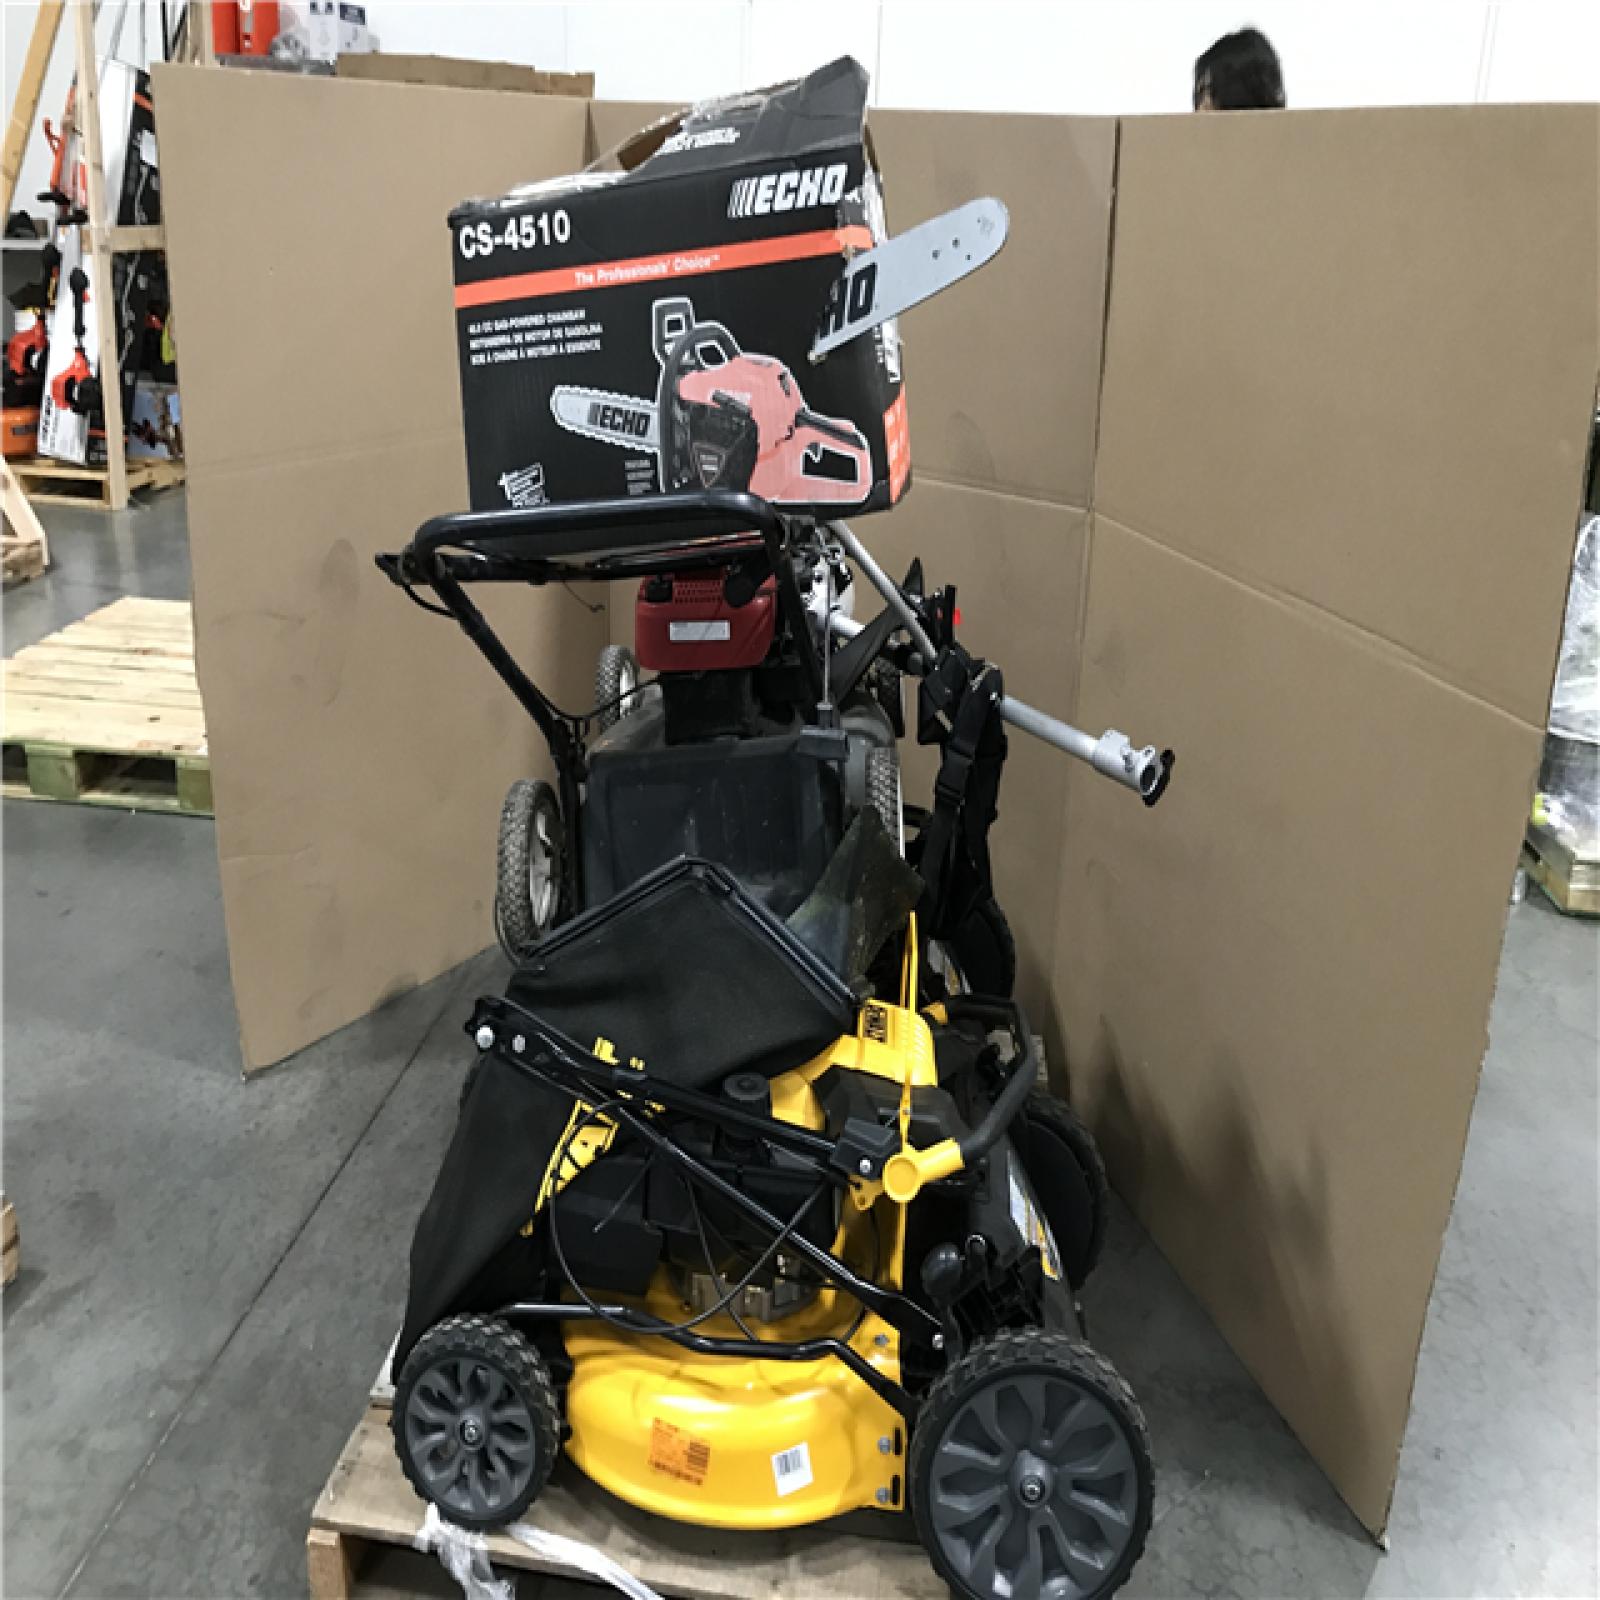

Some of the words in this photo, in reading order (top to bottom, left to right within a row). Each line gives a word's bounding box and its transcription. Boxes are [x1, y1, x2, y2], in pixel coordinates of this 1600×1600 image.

[752, 162, 848, 214] ECHO
[460, 209, 571, 259] CS-4510
[574, 271, 594, 287] The
[599, 404, 651, 438] ECHO
